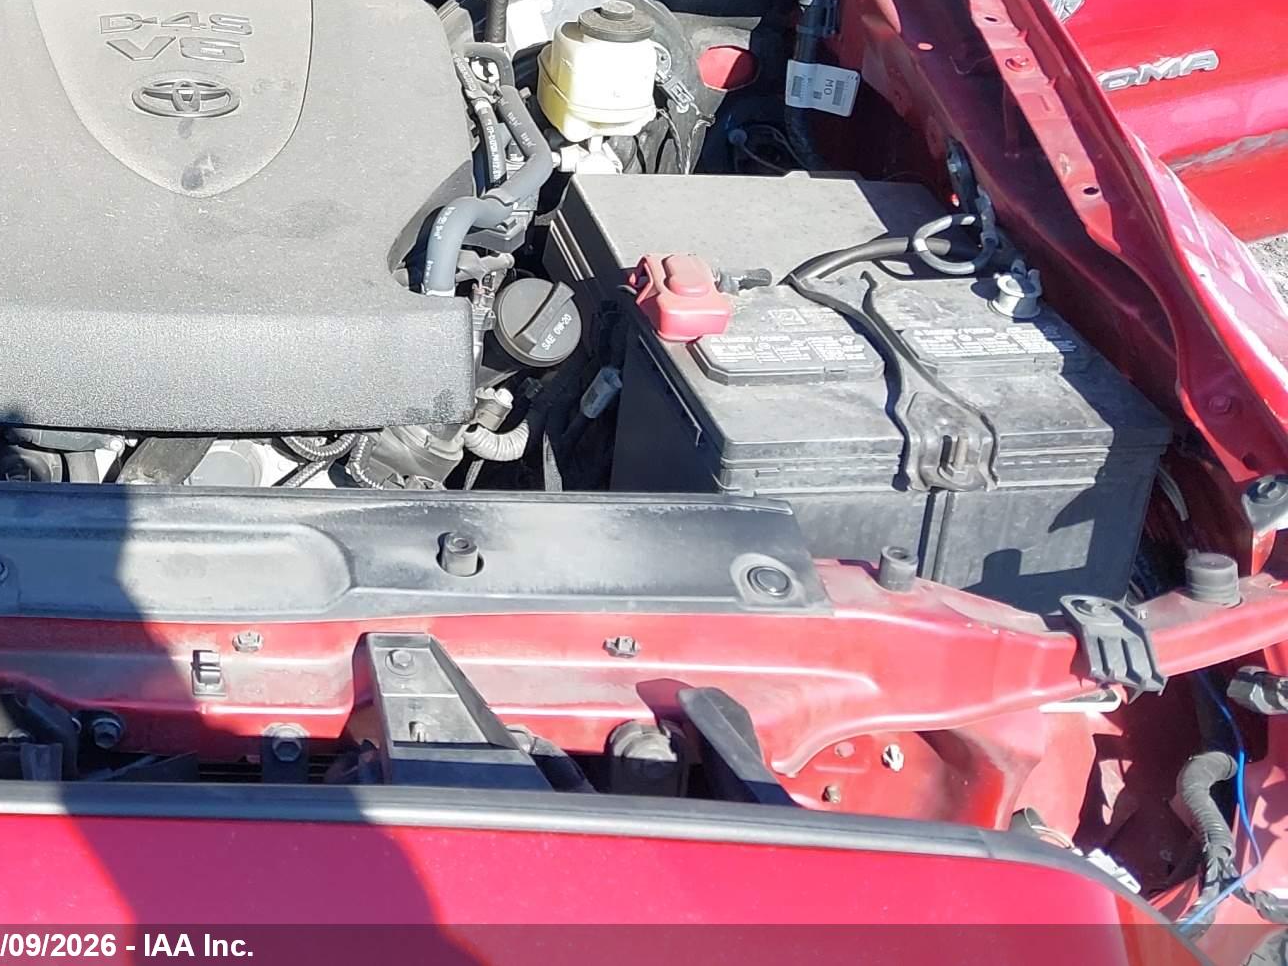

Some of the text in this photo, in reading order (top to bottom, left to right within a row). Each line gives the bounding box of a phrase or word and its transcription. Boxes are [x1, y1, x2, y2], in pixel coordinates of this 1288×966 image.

[100, 11, 253, 35] D-4S
[106, 36, 245, 63] V6
[541, 313, 573, 351] SAE 0W-20
